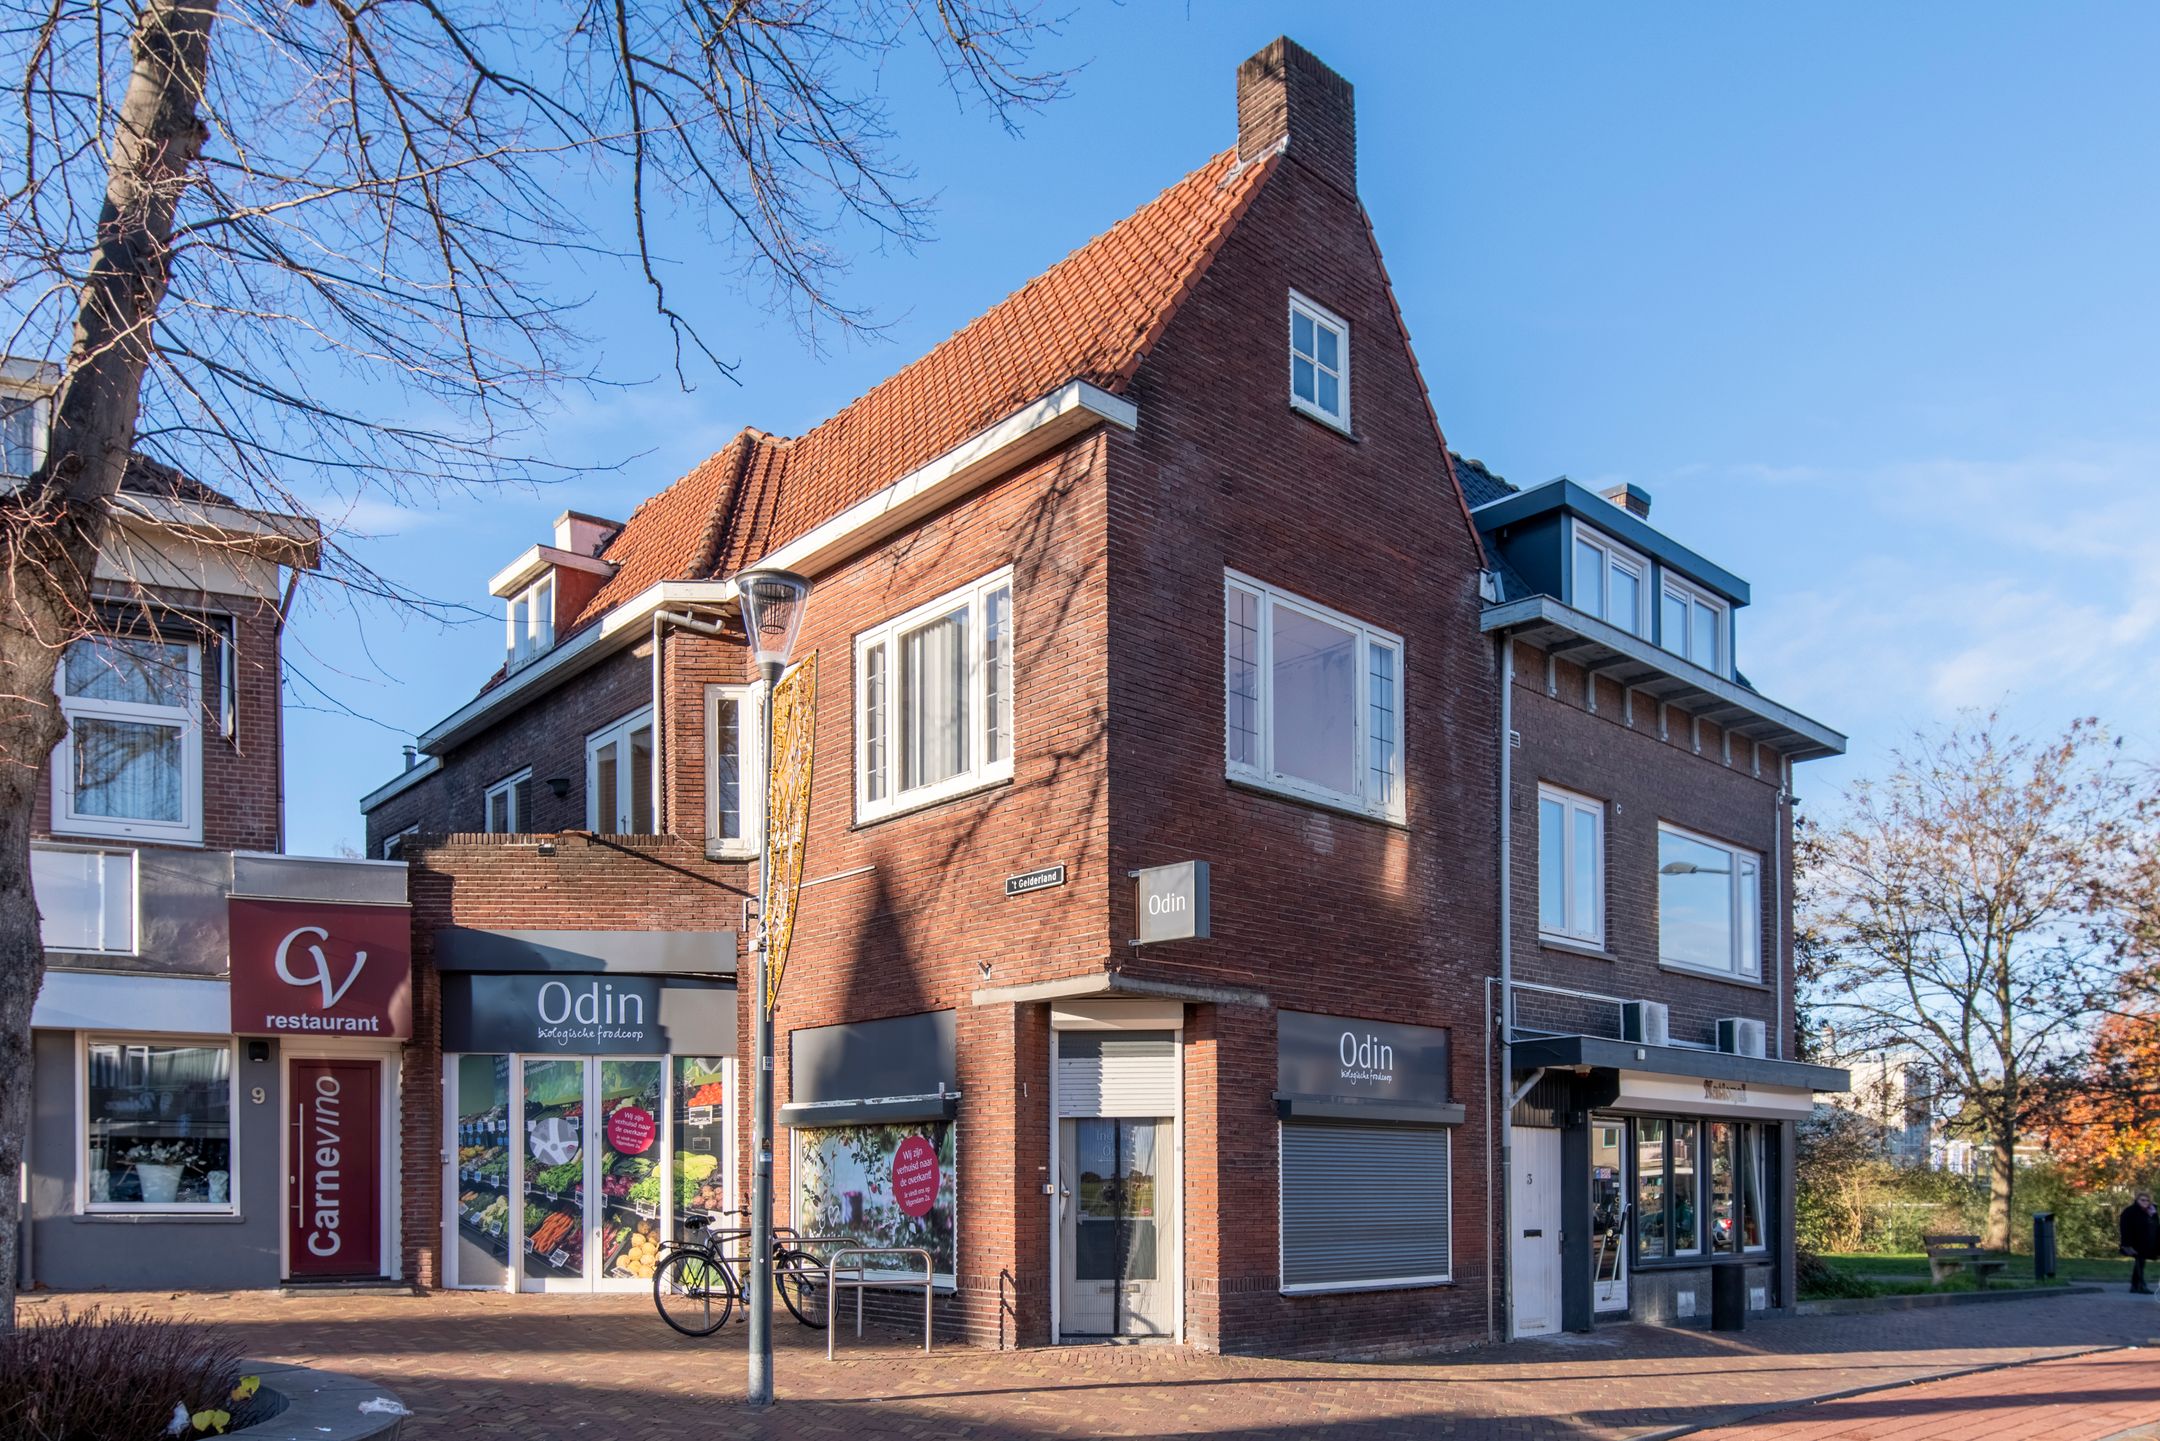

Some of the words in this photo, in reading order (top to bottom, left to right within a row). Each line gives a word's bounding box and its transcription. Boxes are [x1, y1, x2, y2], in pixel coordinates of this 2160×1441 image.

[1011, 880, 1018, 890] 't
[1018, 871, 1057, 888] Gelderland
[1148, 892, 1186, 915] Odin
[537, 981, 643, 1025] Odin
[266, 1013, 379, 1032] restaurant
[538, 1026, 596, 1046] biologische
[597, 1025, 644, 1045] foodcoop
[1340, 1031, 1393, 1070] Odin
[251, 1087, 266, 1105] 9
[615, 1119, 638, 1128] verhuisd
[624, 1112, 633, 1120] Wij
[634, 1114, 644, 1122] zijn
[902, 1149, 912, 1160] Wij
[913, 1148, 923, 1159] zijn
[307, 1075, 341, 1257] Carnevino
[897, 1161, 919, 1175] verhuisd
[919, 1158, 933, 1168] naar
[900, 1178, 907, 1187] de
[908, 1170, 932, 1184] overkant!
[1526, 1173, 1533, 1185] 3
